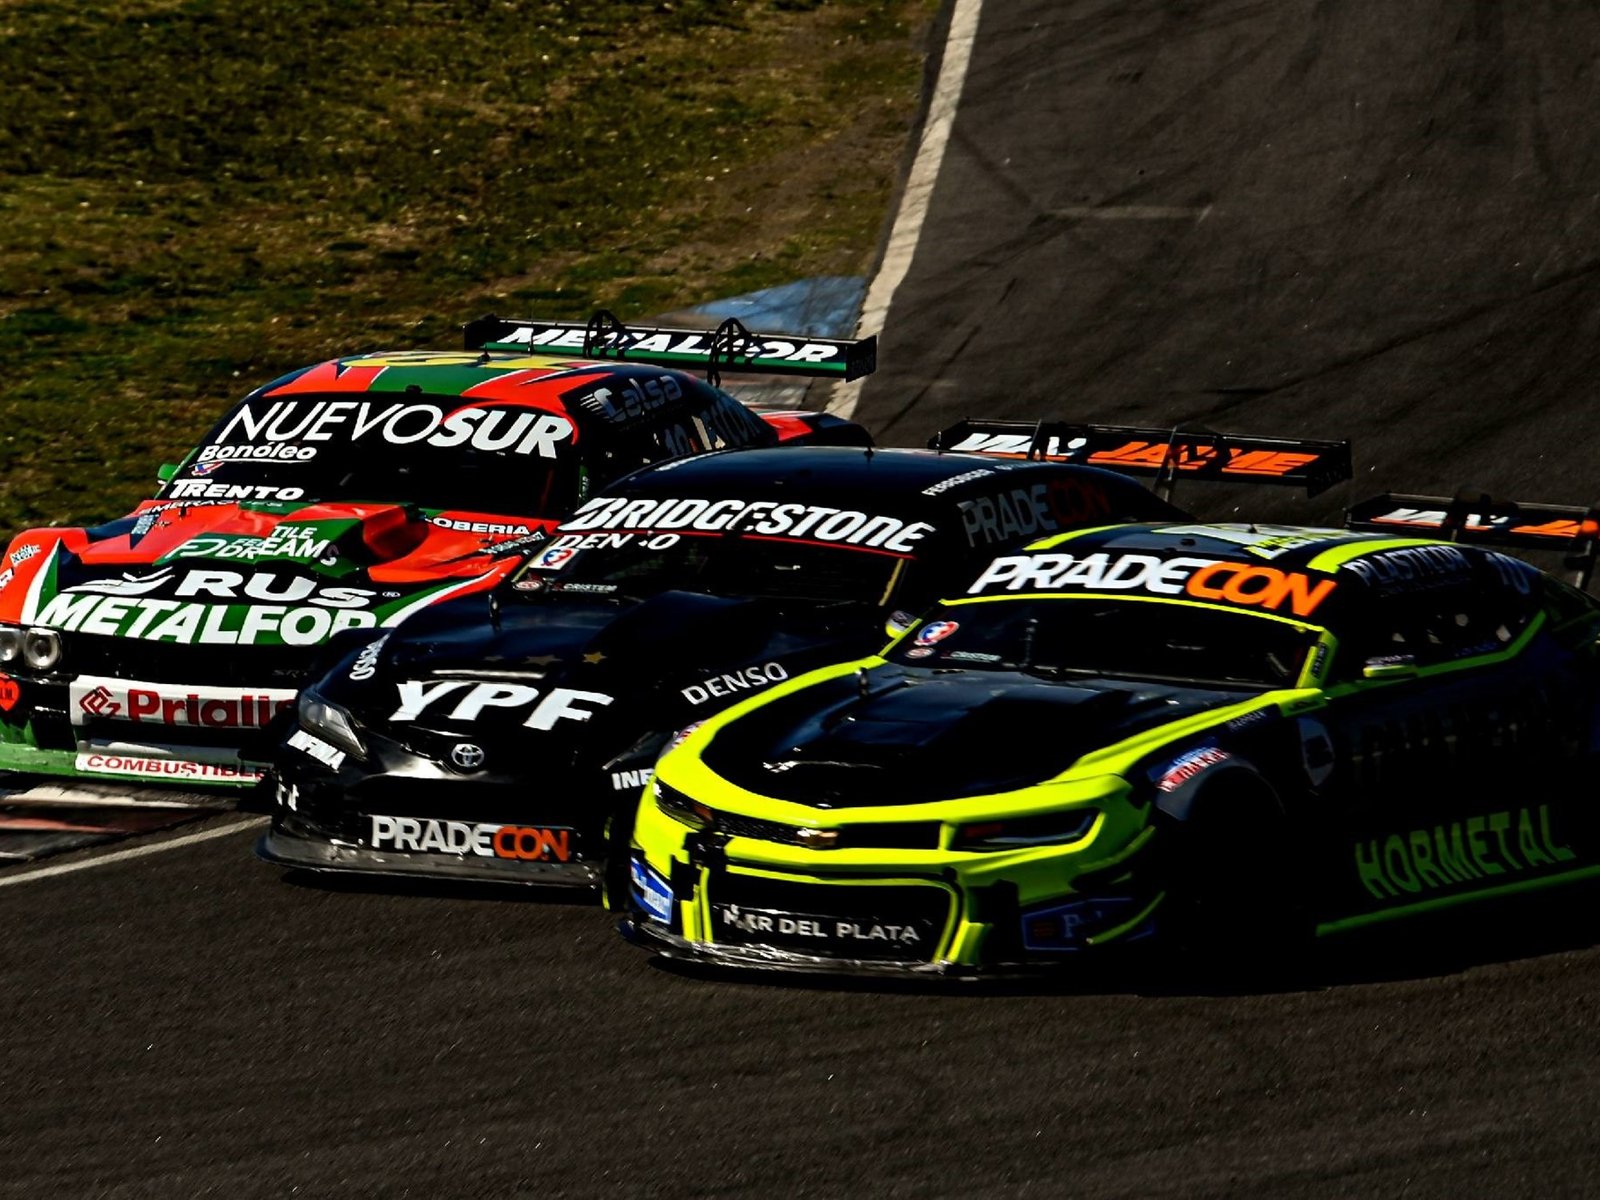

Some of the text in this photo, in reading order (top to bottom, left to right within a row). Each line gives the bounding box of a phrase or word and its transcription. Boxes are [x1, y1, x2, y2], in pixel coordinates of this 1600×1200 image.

[196, 441, 318, 463] Bonóleo
[214, 401, 573, 459] NUEVOSUR
[168, 479, 305, 501] TRENTO
[551, 533, 681, 551] DENO
[557, 497, 938, 552] BRIDGESTONE
[174, 569, 377, 608] RUS
[967, 552, 1338, 618] PRADECON
[388, 680, 614, 731] YPF
[680, 662, 788, 705] DENSO
[371, 815, 569, 862] PRADECON
[1354, 803, 1578, 901] HORMETAL
[778, 917, 828, 938] DEL
[836, 921, 921, 942] PLATA
